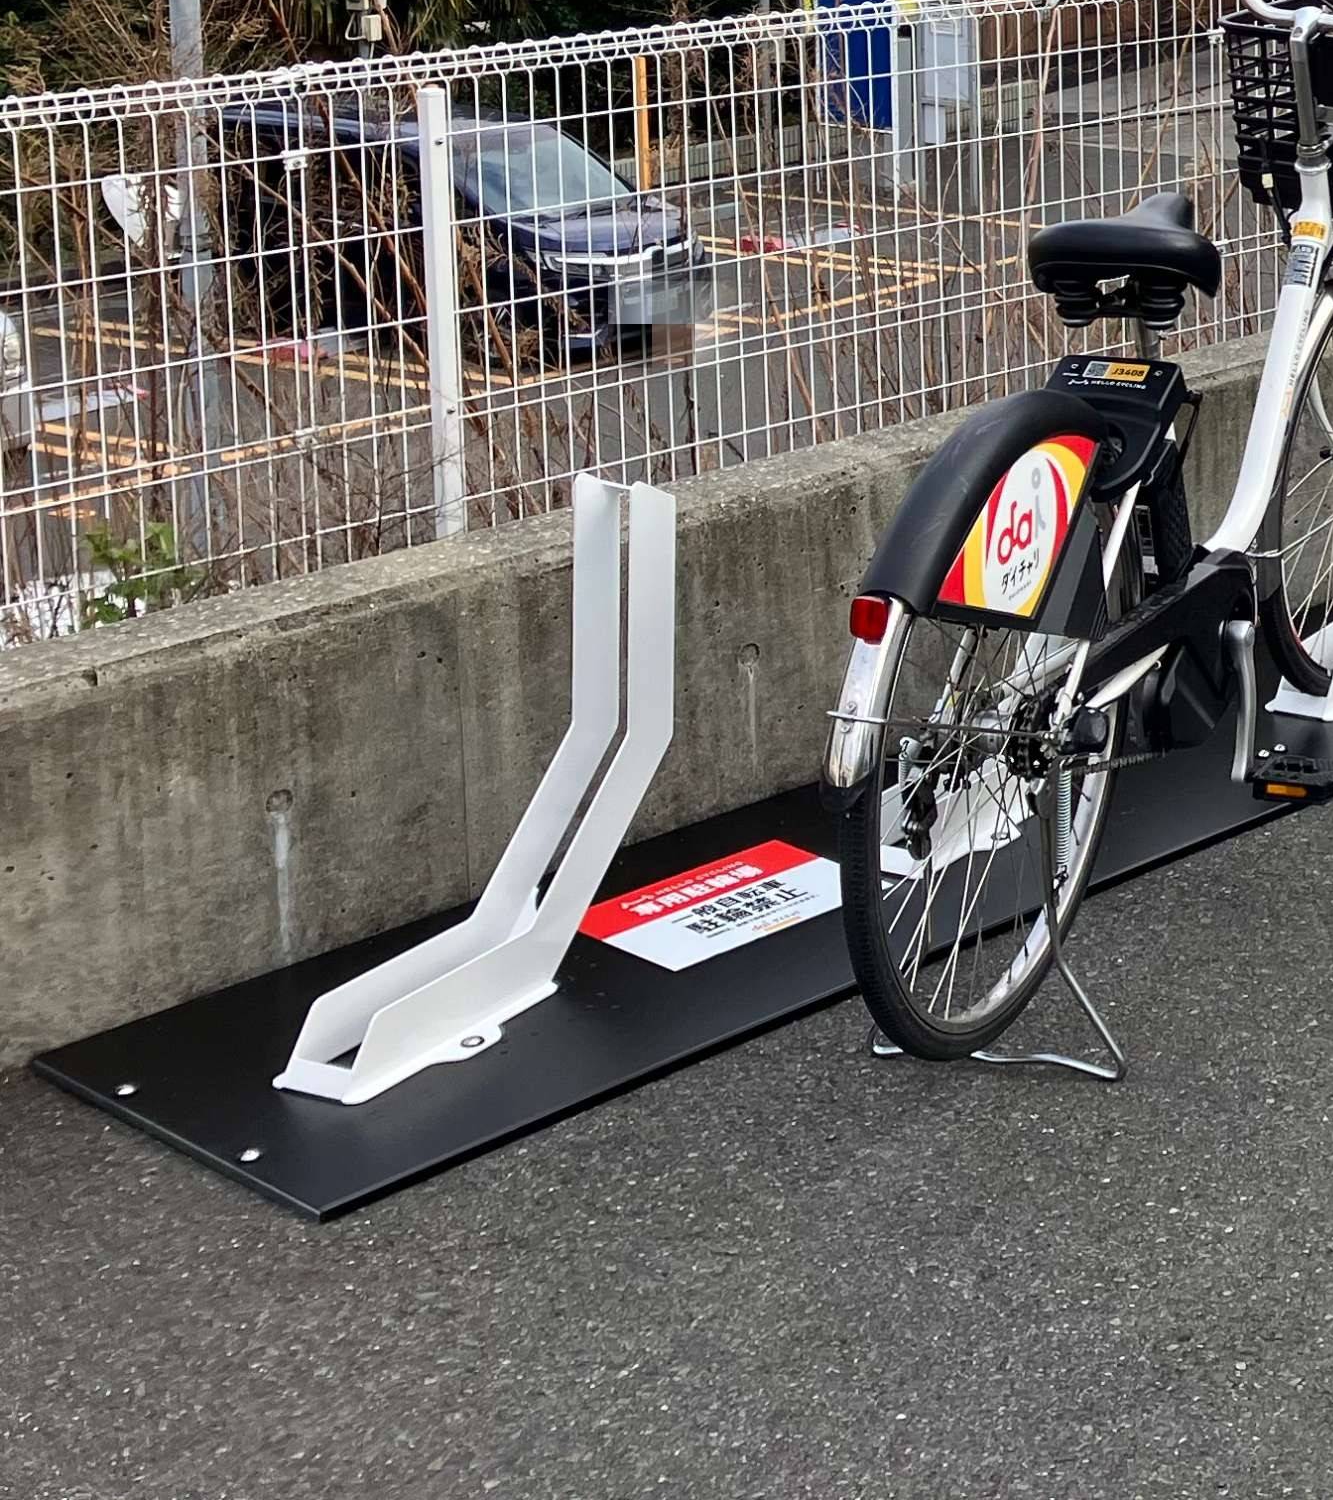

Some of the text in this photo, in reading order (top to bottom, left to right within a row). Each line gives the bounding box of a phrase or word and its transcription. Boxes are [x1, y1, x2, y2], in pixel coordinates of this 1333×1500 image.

[672, 879, 788, 924] 一般自転車
[685, 888, 809, 935] 駐輪禁止
